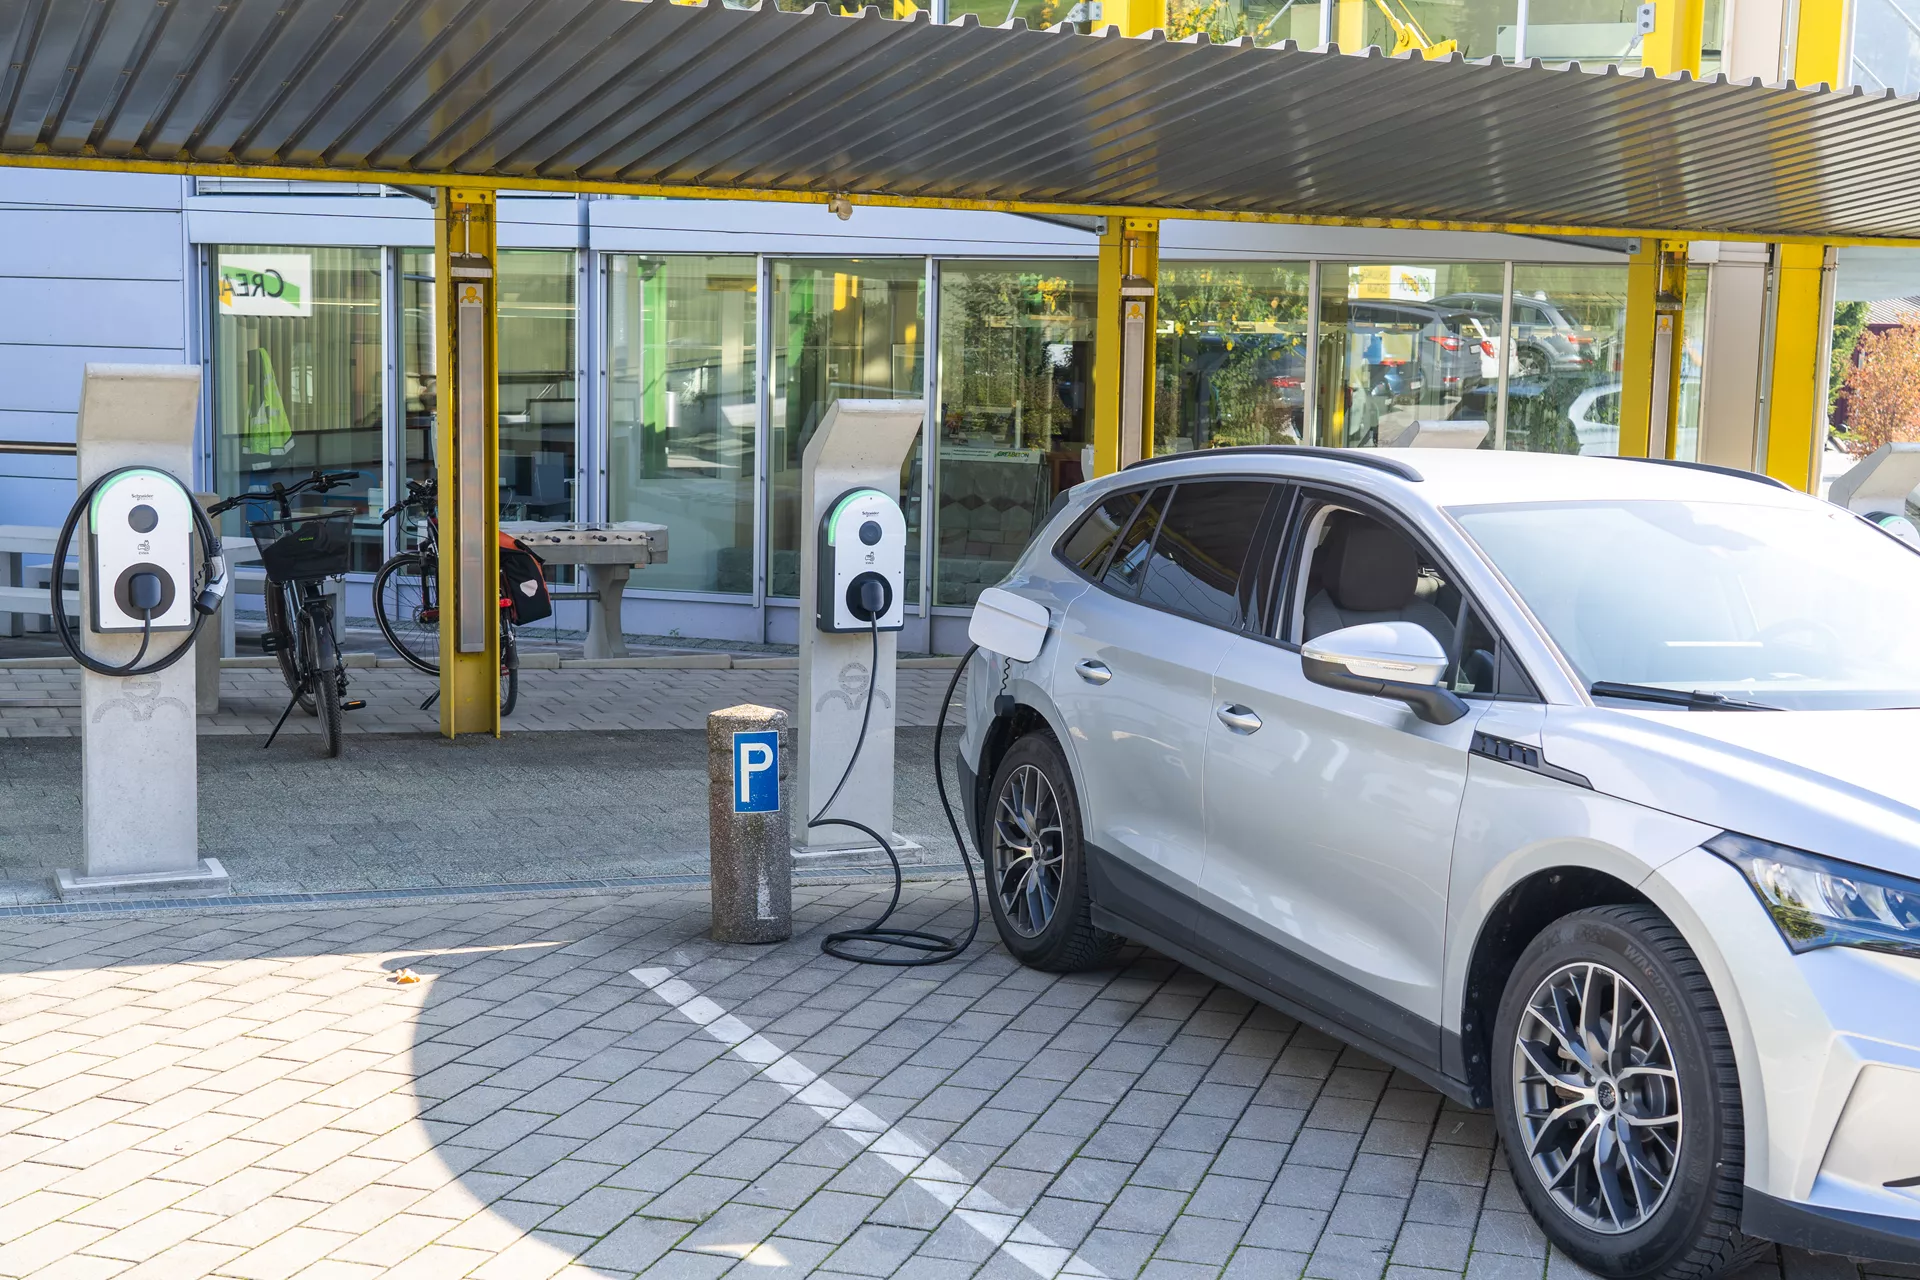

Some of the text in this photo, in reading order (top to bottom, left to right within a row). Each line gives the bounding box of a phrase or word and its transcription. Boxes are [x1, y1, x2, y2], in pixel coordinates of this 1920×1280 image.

[740, 742, 774, 803] P
[1058, 782, 1075, 851] NEXEN
[1622, 944, 1683, 1018] WINGUARD
